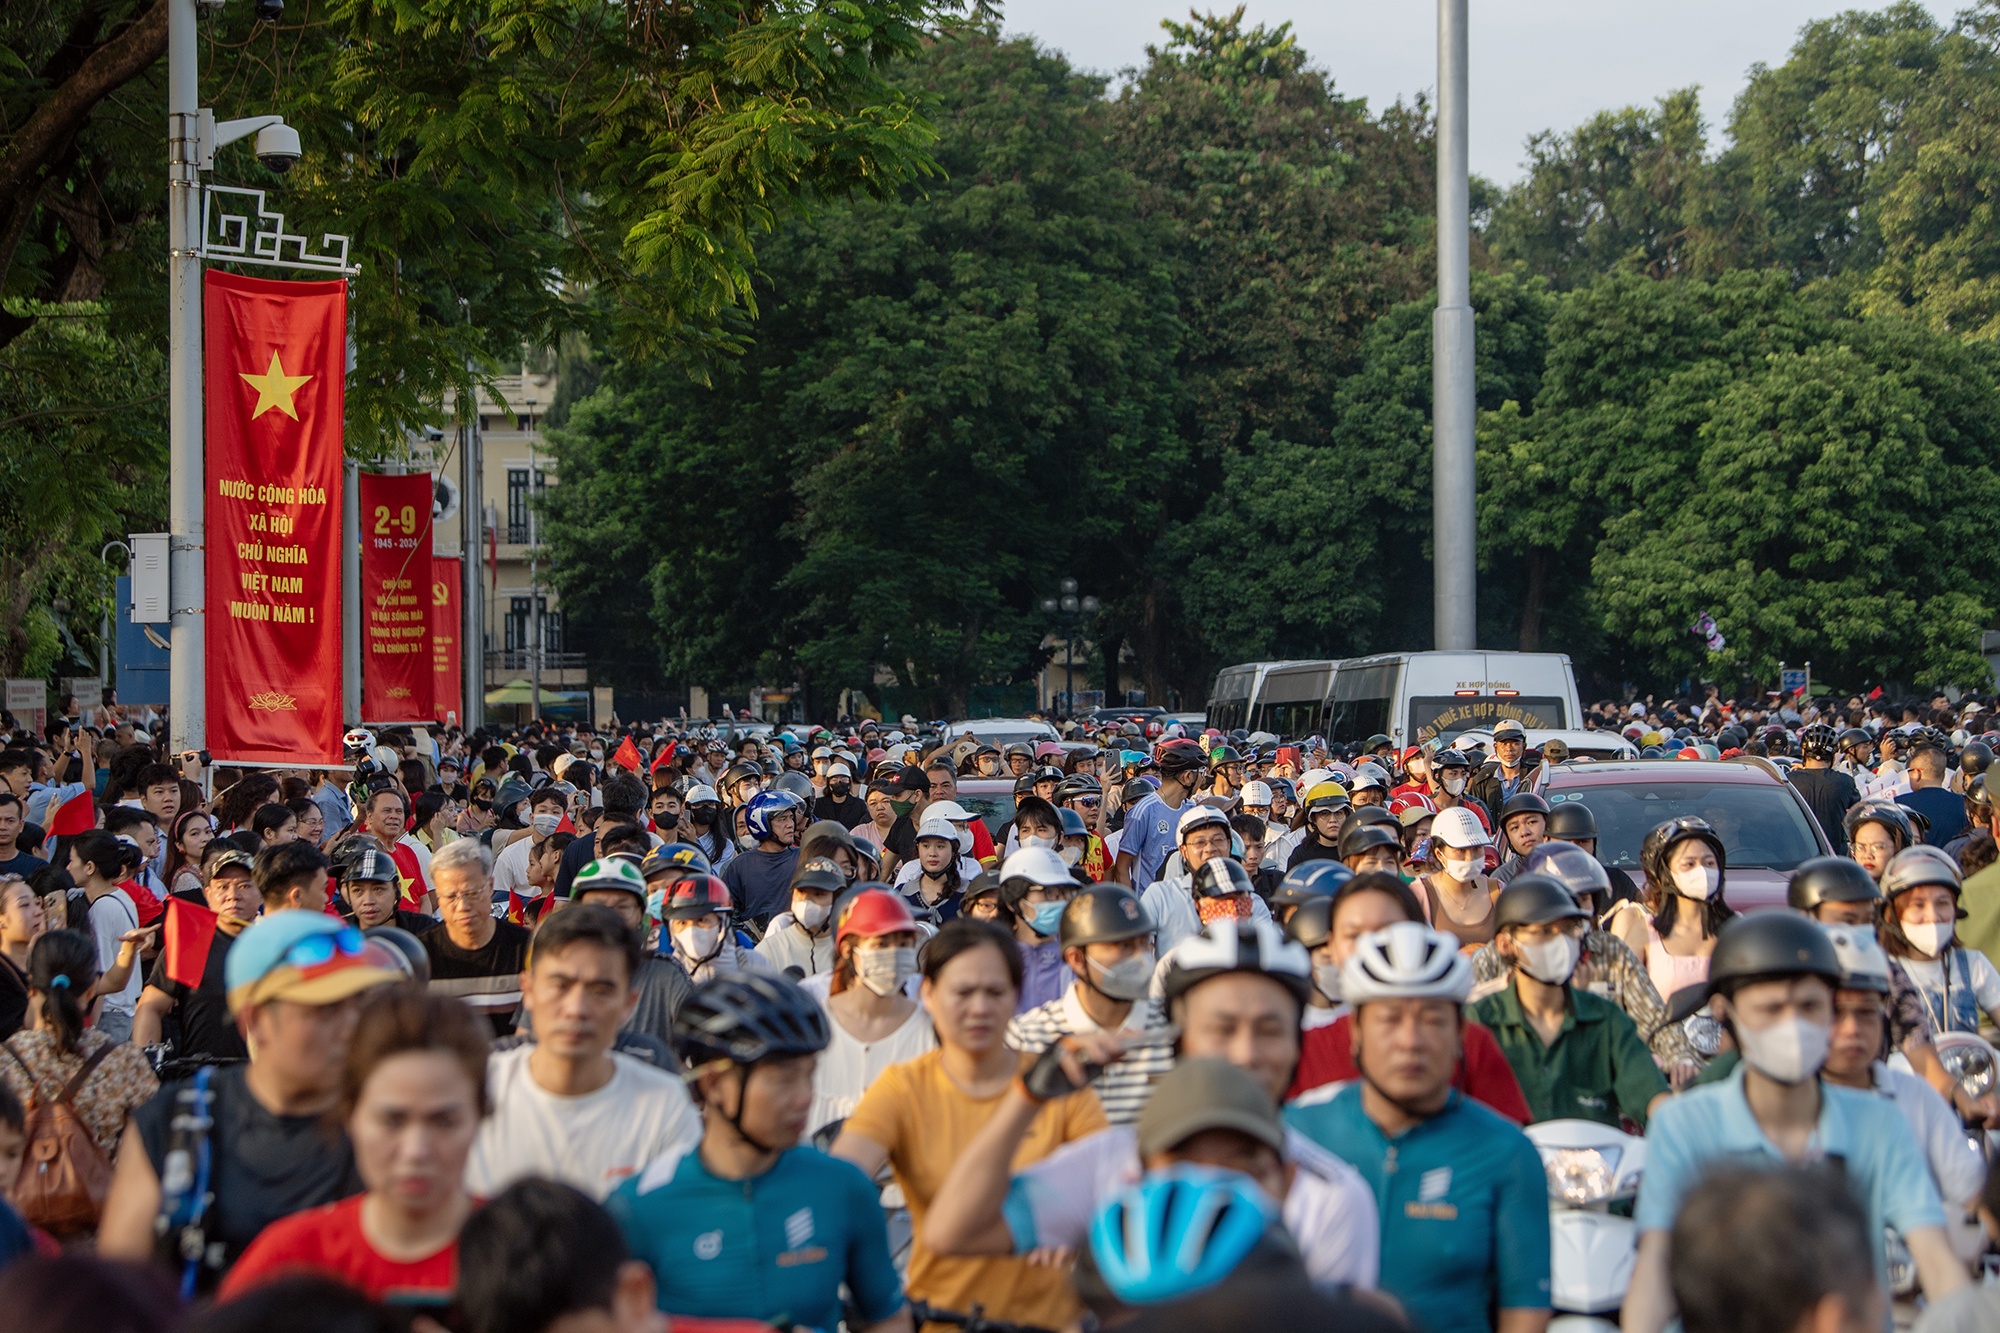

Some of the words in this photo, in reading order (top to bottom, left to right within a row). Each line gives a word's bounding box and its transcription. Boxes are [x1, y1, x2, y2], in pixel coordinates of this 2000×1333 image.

[219, 479, 255, 500] NƯỚC
[258, 483, 295, 507] CỘNG
[298, 484, 327, 505] HÒA
[250, 512, 267, 532] XÃ
[270, 514, 293, 537] HỘI
[374, 505, 416, 534] 2-9
[238, 539, 263, 561] CHỦ
[266, 544, 308, 564] NGHĨA
[374, 538, 392, 548] 1945
[399, 538, 418, 548] 2024
[241, 571, 268, 594] VIỆT
[271, 576, 303, 594] NAM
[231, 600, 270, 620] MUÔN
[273, 603, 305, 624] NĂM
[309, 607, 315, 624] !
[1456, 681, 1467, 689] XE
[1432, 706, 1459, 731] THUÊ
[1458, 705, 1472, 719] XE
[1473, 702, 1495, 719] HỢP
[1523, 712, 1538, 728] DU
